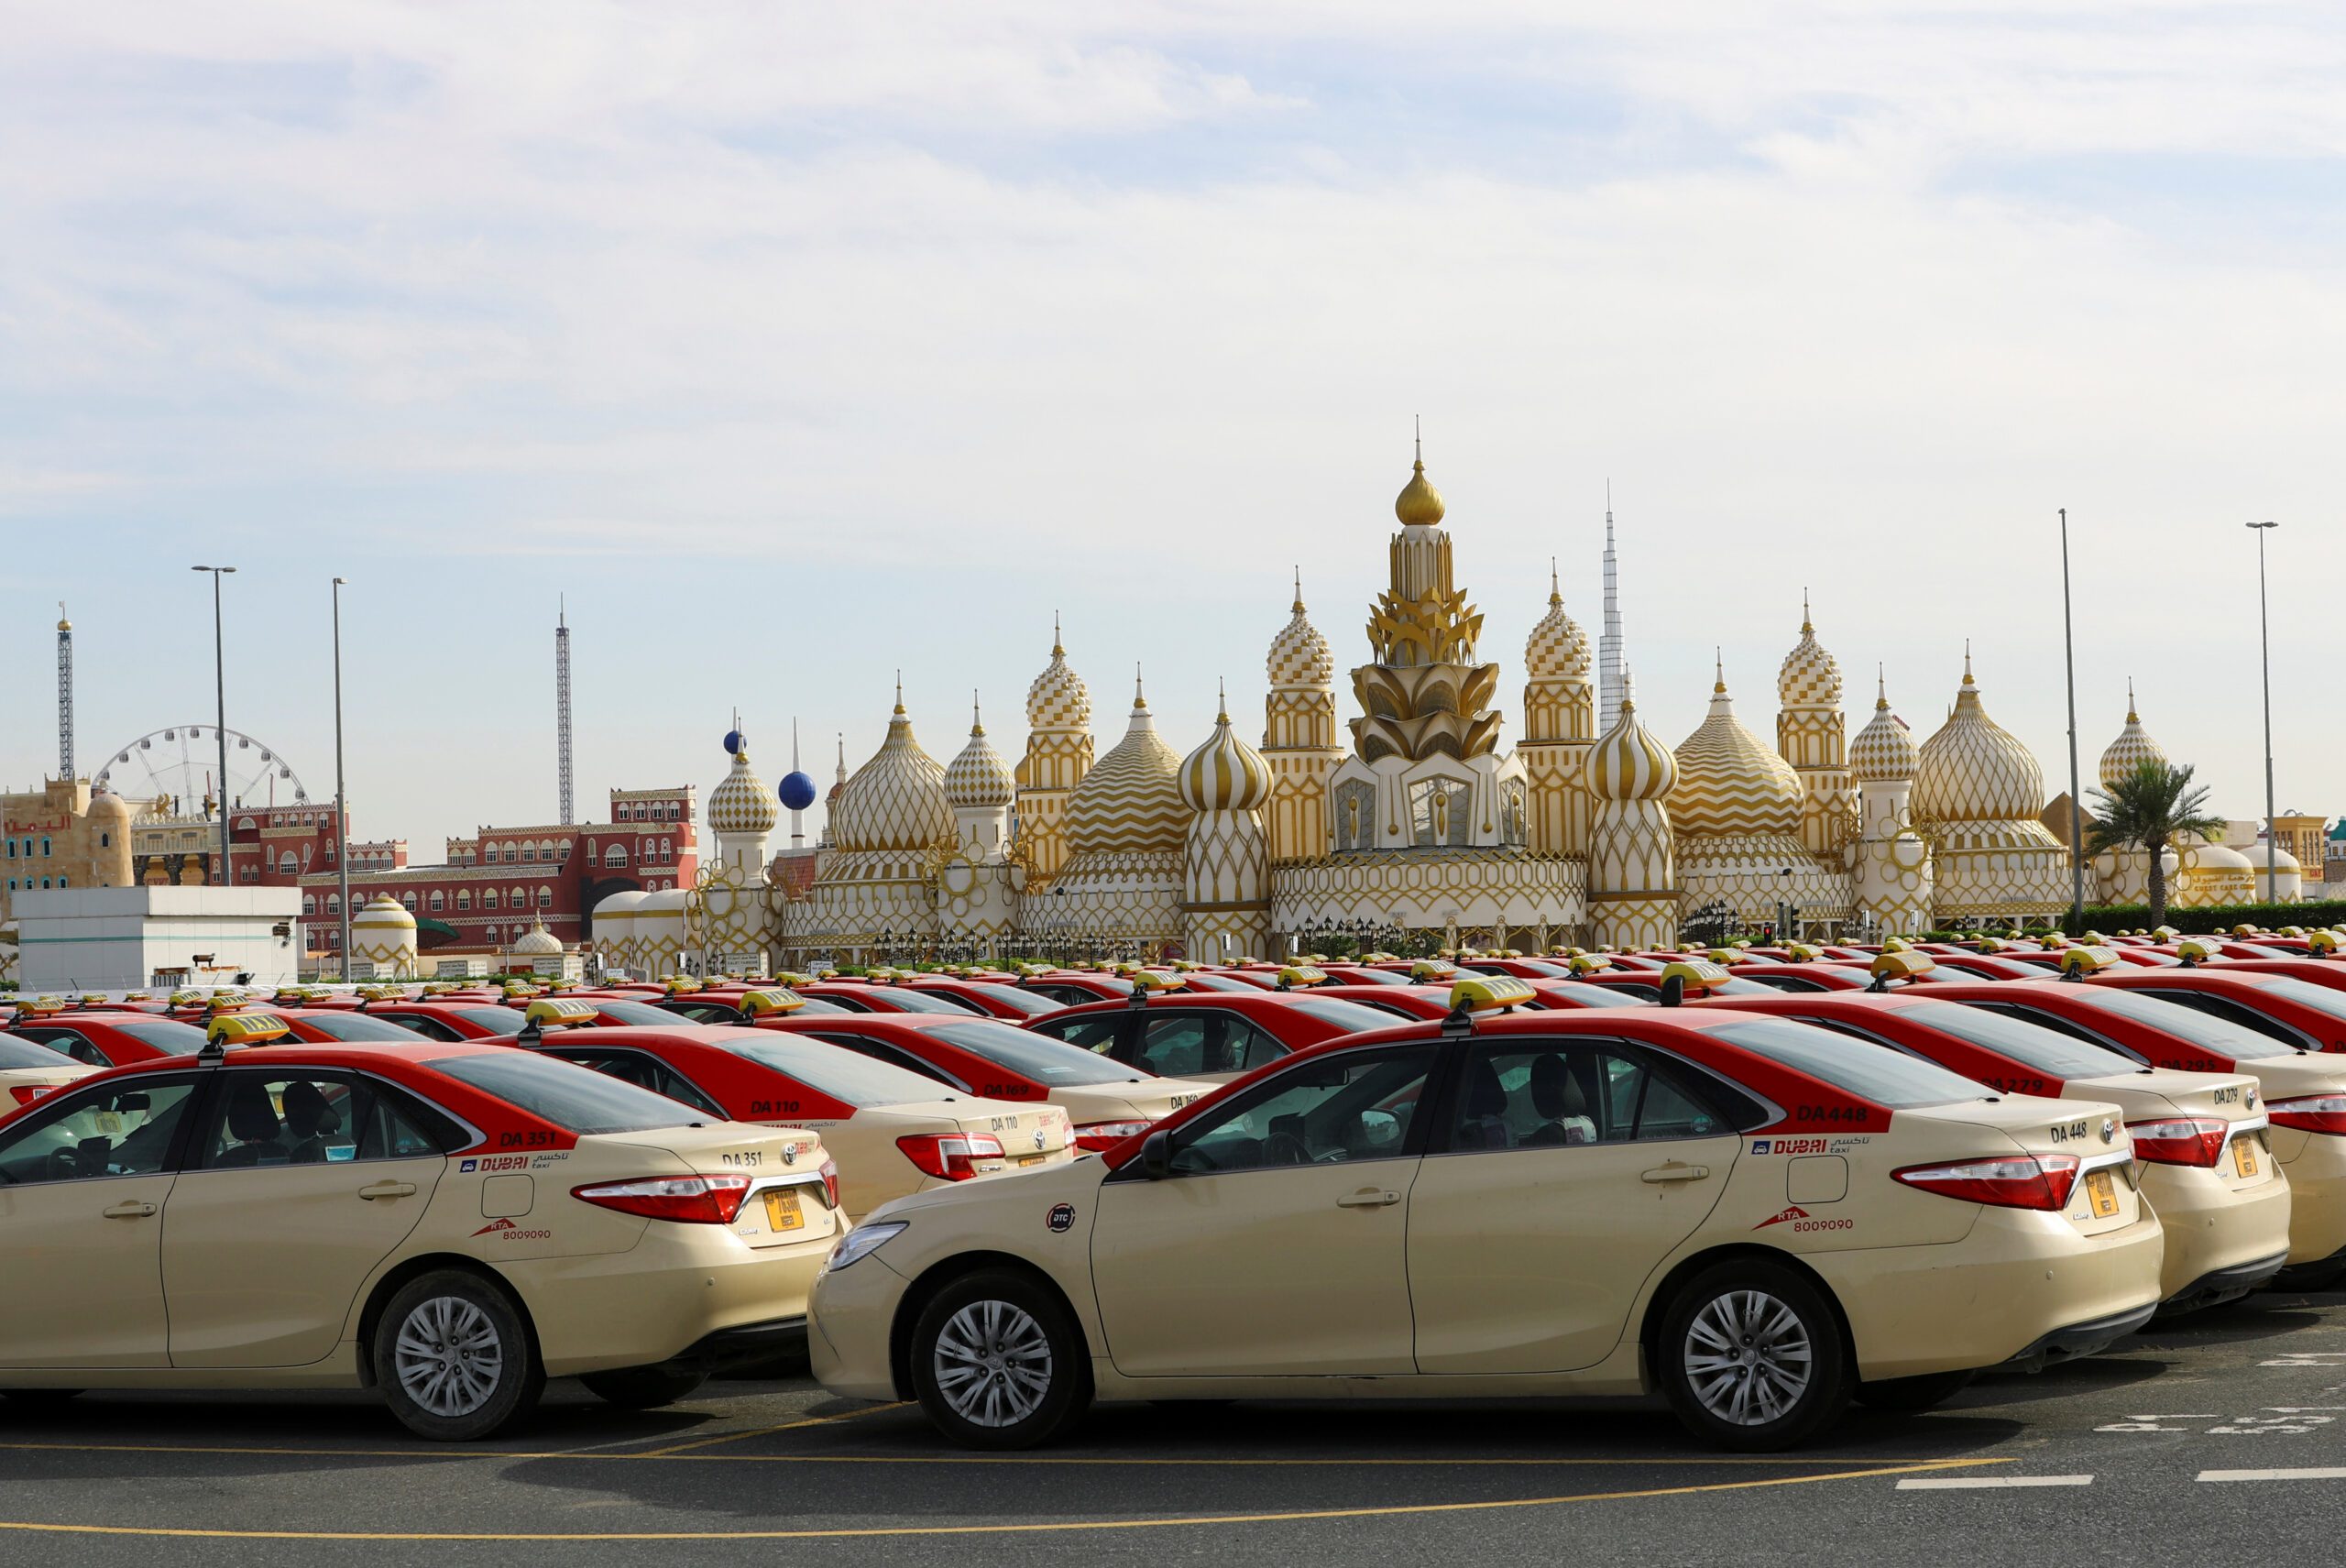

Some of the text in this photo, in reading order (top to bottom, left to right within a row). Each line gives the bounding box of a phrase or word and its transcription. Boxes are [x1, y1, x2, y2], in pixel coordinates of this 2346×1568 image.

[1484, 978, 1530, 996] TAXI
[763, 990, 803, 1004] TAXI
[552, 1001, 594, 1014] TAXI
[236, 1014, 284, 1031] TAXI
[2335, 1040, 2346, 1052] D
[2186, 1059, 2216, 1071] 295
[984, 1084, 1029, 1096] DA 169
[2007, 1079, 2044, 1091] 279
[1170, 1096, 1183, 1110] DA
[2214, 1088, 2238, 1105] DA 279
[751, 1101, 800, 1113] DA 110
[1797, 1105, 1868, 1122] DA 448
[992, 1116, 1018, 1132] DA 110
[499, 1131, 557, 1146] DA 351
[2051, 1122, 2087, 1144] DA 448
[1774, 1139, 1827, 1156] DUBAI
[1830, 1136, 1871, 1146] تاكسي
[480, 1157, 529, 1172] DUBAI
[533, 1153, 570, 1163] تاكسي
[722, 1151, 762, 1167] DA 351
[1053, 1213, 1069, 1223] DTC
[1778, 1212, 1802, 1221] RTA
[1794, 1219, 1854, 1233] 8009090
[503, 1230, 552, 1241] 8009090
